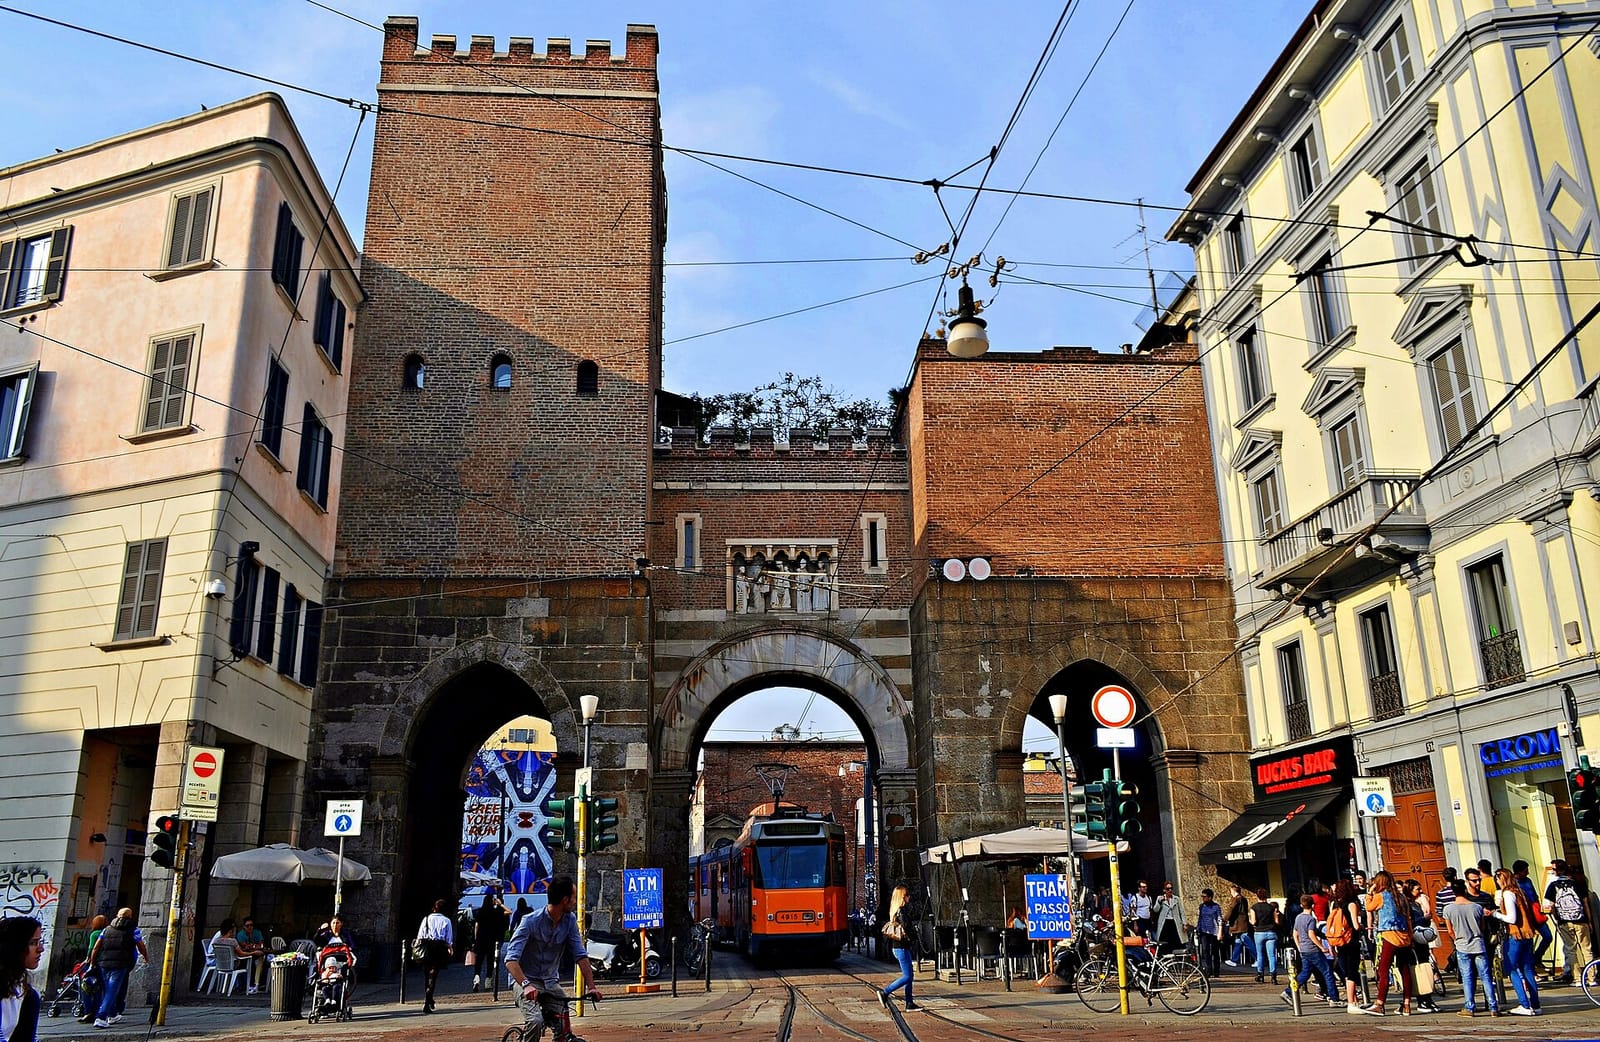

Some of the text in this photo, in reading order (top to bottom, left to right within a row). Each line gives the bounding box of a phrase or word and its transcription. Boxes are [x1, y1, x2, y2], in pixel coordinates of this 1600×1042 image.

[1480, 728, 1562, 767] GROM
[1257, 756, 1303, 785] LUCA'S
[1303, 748, 1337, 775] BAR
[1361, 785, 1385, 793] pedonale
[467, 814, 502, 825] YOUR
[468, 826, 498, 836] RUN
[628, 876, 657, 892] ATM
[1026, 880, 1068, 898] TRAM
[637, 898, 649, 906] FINE
[1028, 920, 1071, 932] D'UOMO
